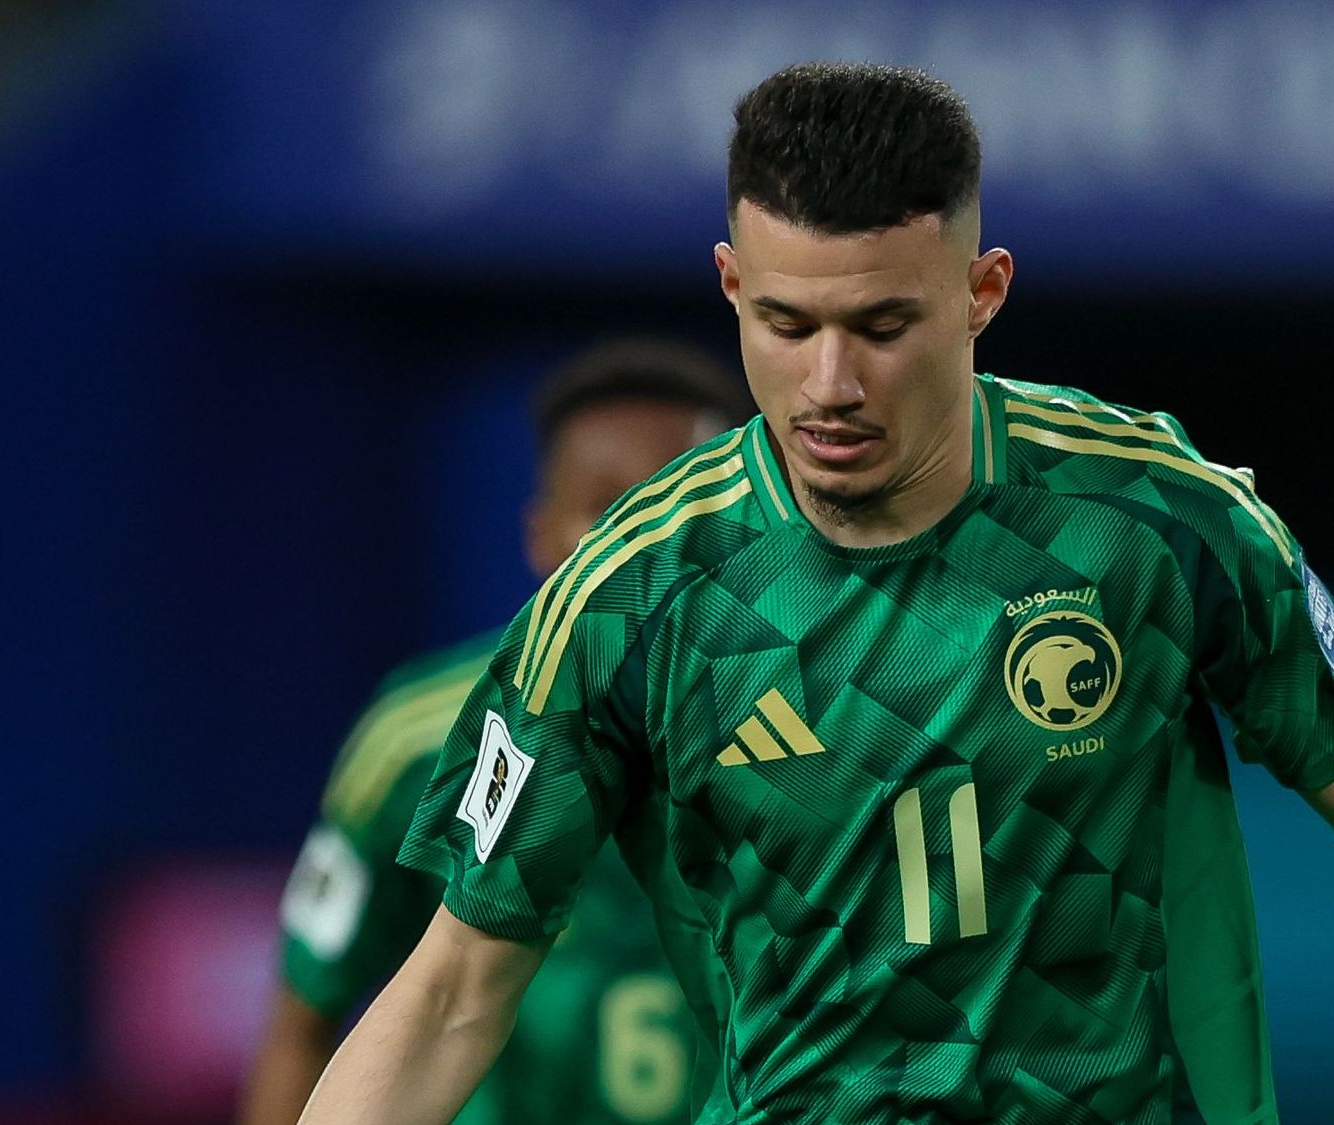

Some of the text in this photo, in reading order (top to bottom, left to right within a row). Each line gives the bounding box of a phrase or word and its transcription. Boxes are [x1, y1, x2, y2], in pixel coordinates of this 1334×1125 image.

[1003, 587, 1098, 618] السعودية
[1069, 677, 1102, 693] SAFF
[1045, 735, 1105, 763] SAUDI
[893, 782, 988, 945] 11
[597, 974, 689, 1123] 6
